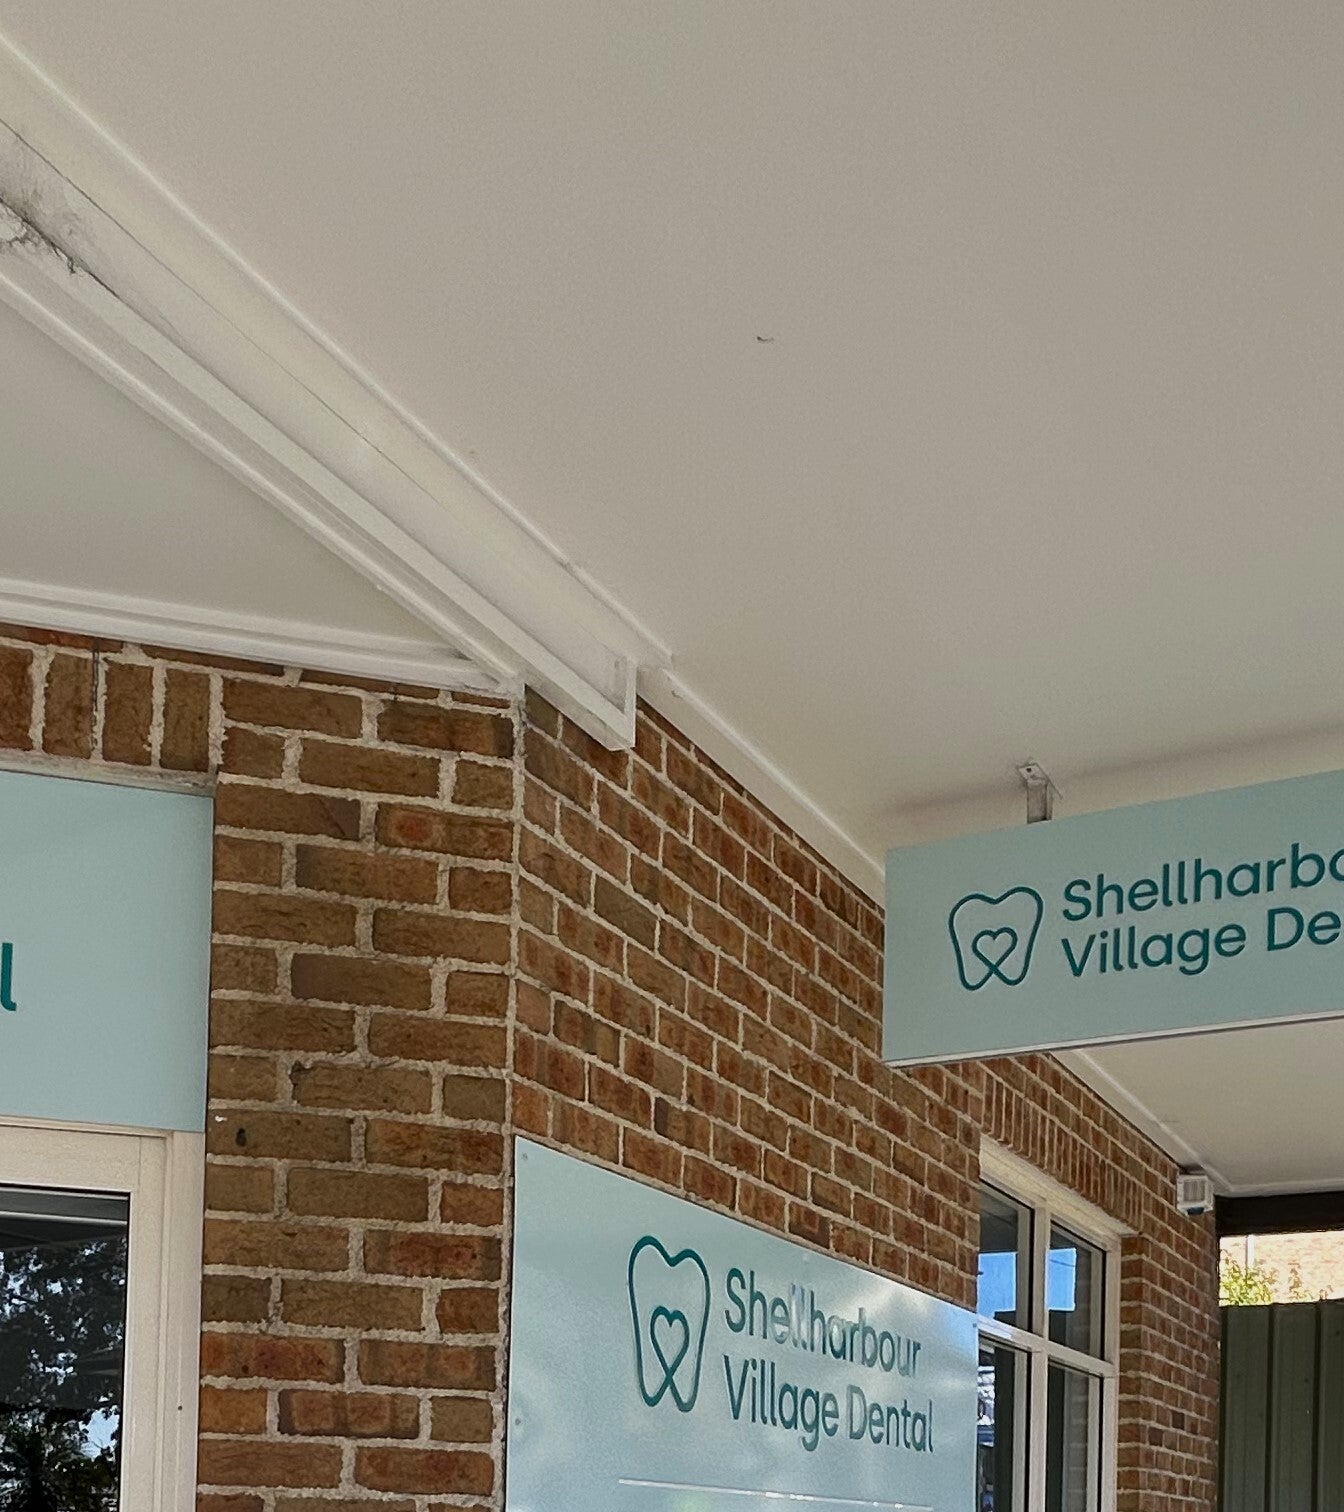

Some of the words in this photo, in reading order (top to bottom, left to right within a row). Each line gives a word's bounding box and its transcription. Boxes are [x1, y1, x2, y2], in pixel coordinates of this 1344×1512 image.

[1062, 919, 1246, 978] Village
[725, 1267, 921, 1379] Shellharbour
[723, 1355, 839, 1451] Village
[849, 1385, 934, 1453] Dental
